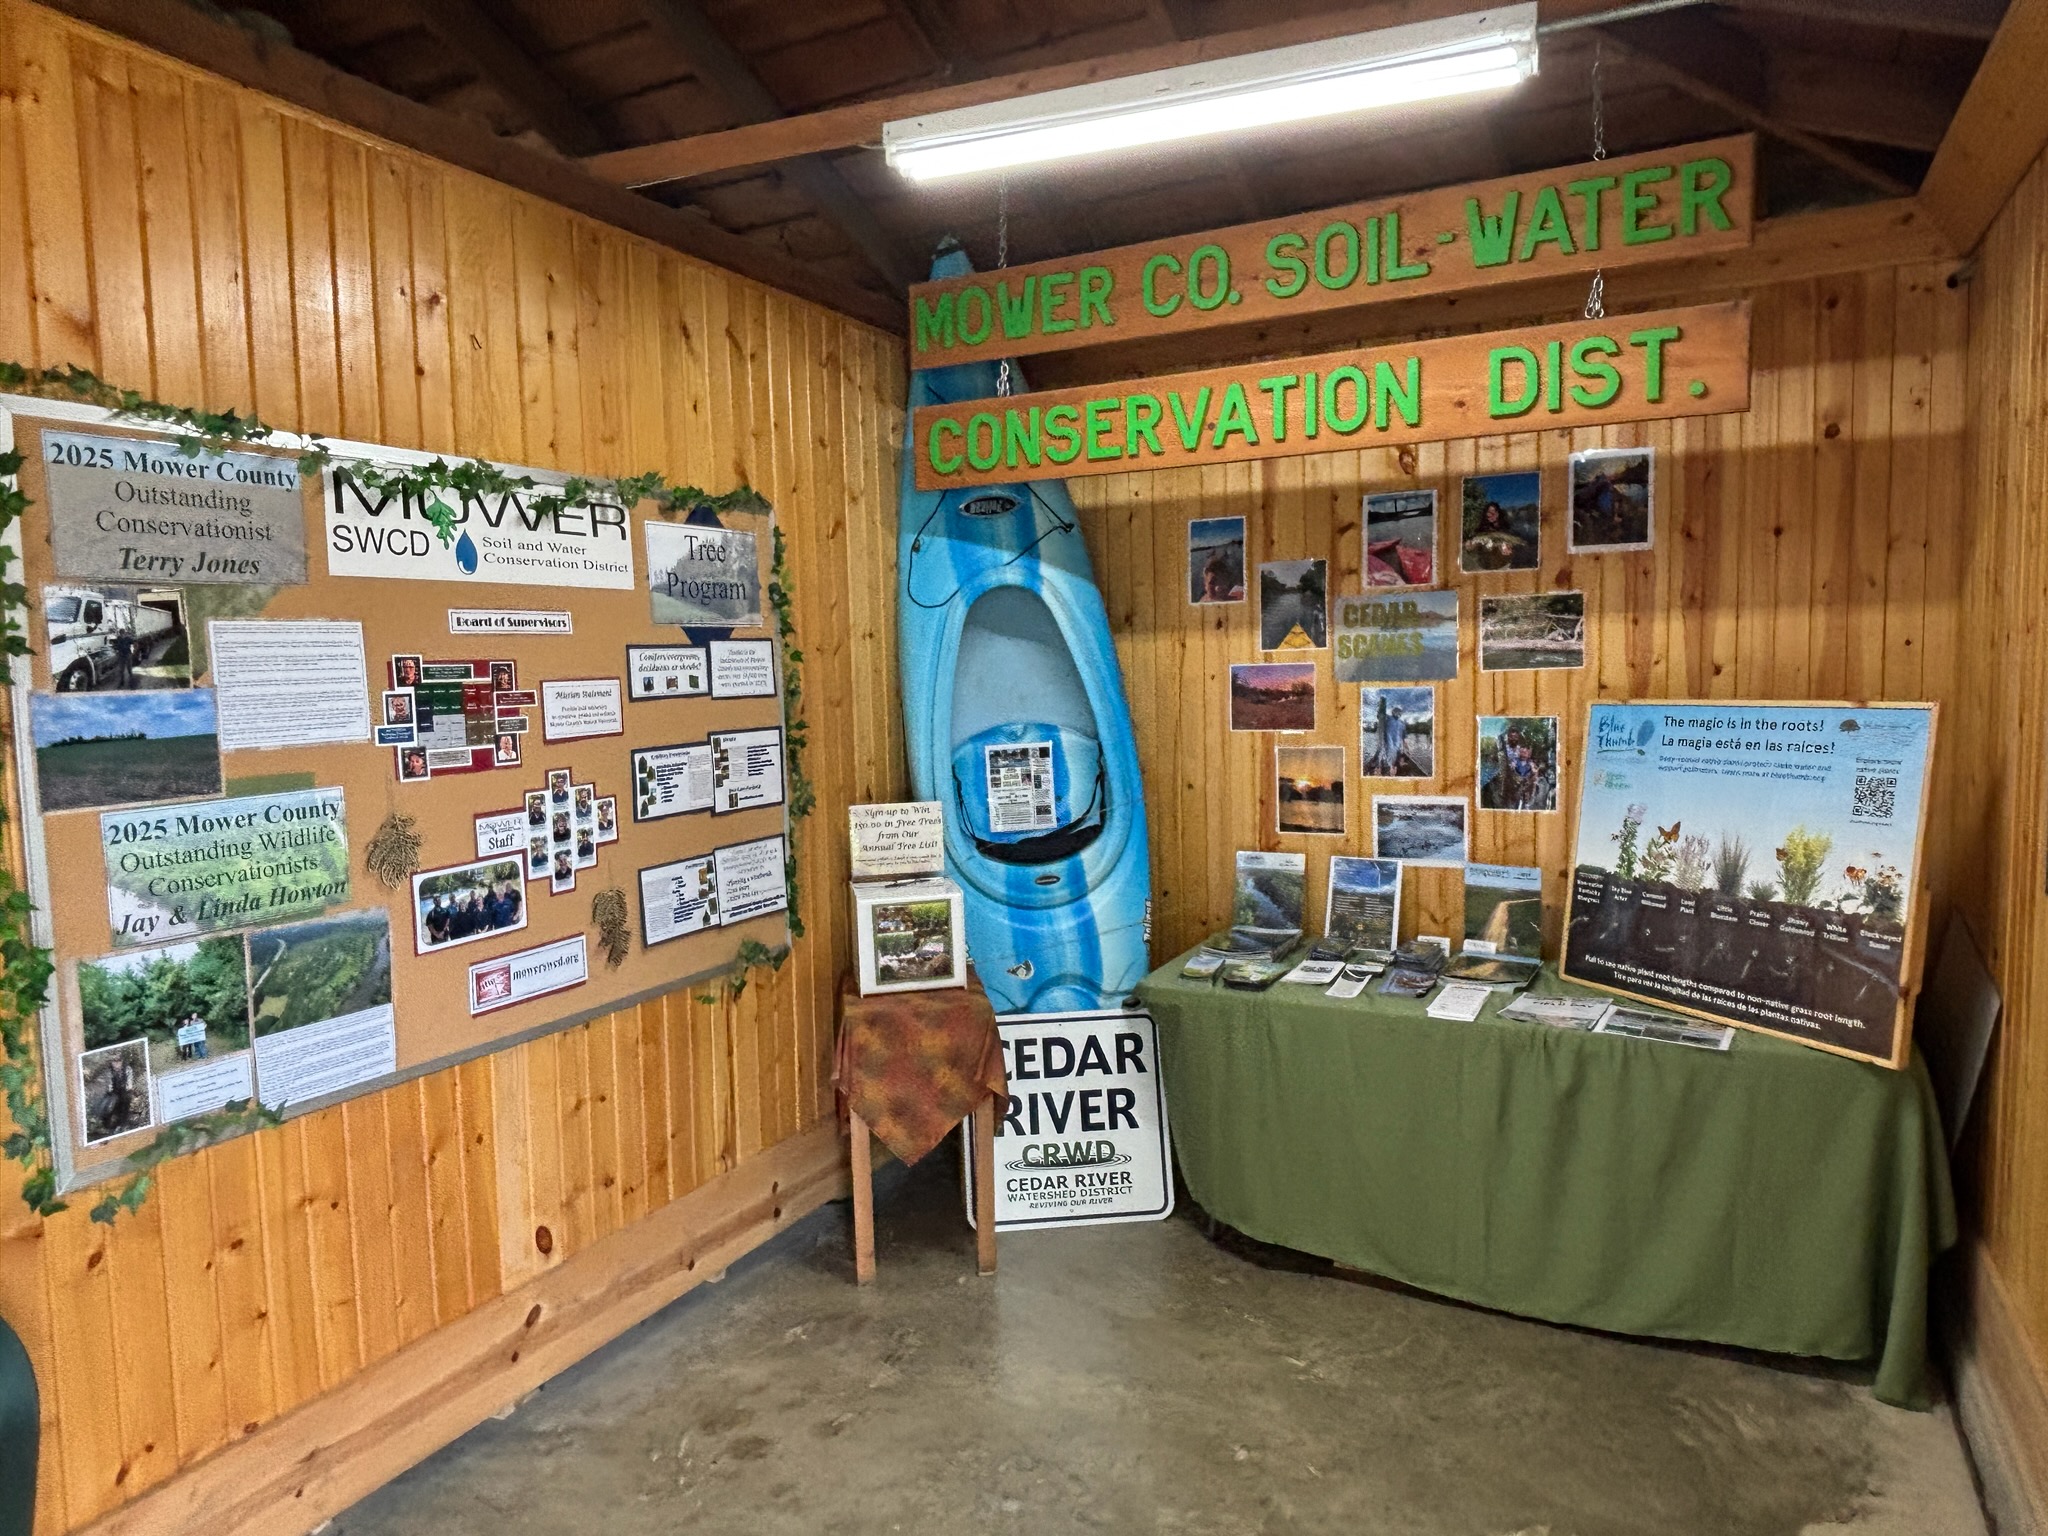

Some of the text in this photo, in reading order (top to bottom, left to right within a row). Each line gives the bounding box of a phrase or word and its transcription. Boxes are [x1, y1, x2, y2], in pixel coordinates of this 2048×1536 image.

[915, 156, 1733, 353] MOWER CO. SOIL-WATER
[927, 324, 1709, 475] CONSERVATION DIST.
[50, 441, 298, 493] 2025 Mower County
[113, 479, 253, 518] Outstanding
[95, 509, 273, 542] Conservationist
[331, 523, 431, 558] SWCD
[481, 535, 588, 557] Soil and Water
[683, 534, 727, 564] Tree
[119, 547, 262, 578] Terry Jones
[482, 551, 630, 574] Conservation District
[666, 571, 747, 607] Program
[456, 616, 568, 629] Board of Supervisors
[1342, 599, 1421, 630] CEDAR
[1663, 715, 1825, 732] The magic is in the roots!
[1661, 734, 1836, 755] La magia está en las raíces!
[107, 800, 341, 847] 2025 Mower County
[894, 819, 916, 829] Free
[900, 807, 910, 816] to
[910, 805, 931, 814] Win
[119, 824, 337, 873] Outstanding Wildlife
[488, 832, 516, 850] Staff
[860, 841, 897, 853] Annual
[896, 841, 917, 851] Tree
[876, 829, 920, 843] from Our
[148, 853, 319, 898] Conservationists
[115, 879, 348, 938] Jay & Linda Howton
[1679, 906, 1695, 916] Plant
[1749, 909, 1771, 920] Prairie
[1825, 923, 1848, 934] White
[1584, 954, 1597, 964] Pull
[1616, 962, 1637, 974] native
[1636, 967, 1655, 979] plant
[1655, 972, 1671, 982] root
[1698, 982, 1736, 998] compared
[1736, 991, 1746, 1001] to
[1746, 994, 1790, 1011] non-native
[1790, 1005, 1813, 1017] grass
[1813, 1010, 1834, 1022] root
[1834, 1013, 1867, 1030] length.
[1613, 970, 1627, 981] Tire
[1626, 975, 1642, 986] para
[1661, 983, 1691, 997] longitud
[1691, 990, 1701, 1000] de
[1701, 994, 1712, 1003] las
[1736, 1002, 1748, 1012] de
[1759, 1008, 1790, 1023] plantas
[1790, 1016, 1822, 1030] nativas.
[996, 1087, 1140, 1138] RIVER
[1021, 1139, 1117, 1167] CRWD
[1006, 1171, 1133, 1193] CEDAR RIVER
[1006, 1185, 1133, 1203] WATERSHED DISTRICT
[1028, 1196, 1114, 1210] REVIVING OUR RIVER
